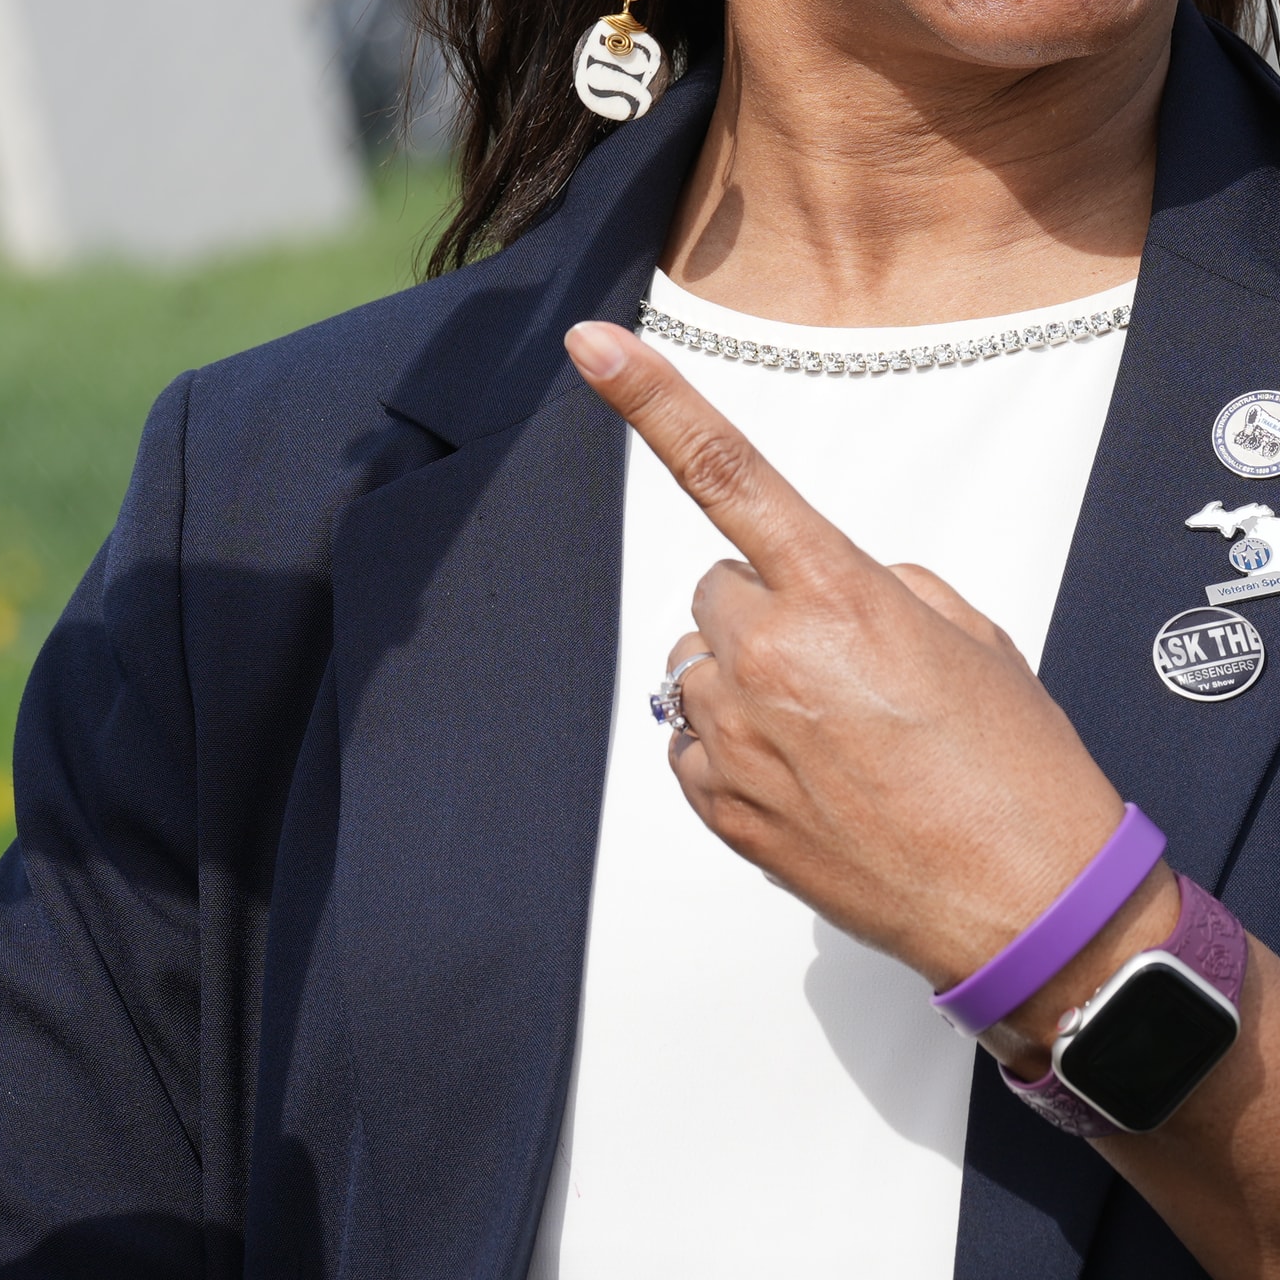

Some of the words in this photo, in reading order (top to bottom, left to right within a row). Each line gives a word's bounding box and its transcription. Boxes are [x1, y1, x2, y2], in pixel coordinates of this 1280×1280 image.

[1229, 394, 1257, 412] CENTRAL
[1257, 393, 1275, 401] HIGH
[1217, 582, 1260, 596] Veteran
[1158, 632, 1208, 669] ASK
[1207, 622, 1261, 657] THE
[1177, 660, 1254, 685] MESSENGERS
[1197, 683, 1210, 691] TV
[1212, 678, 1235, 688] Show
